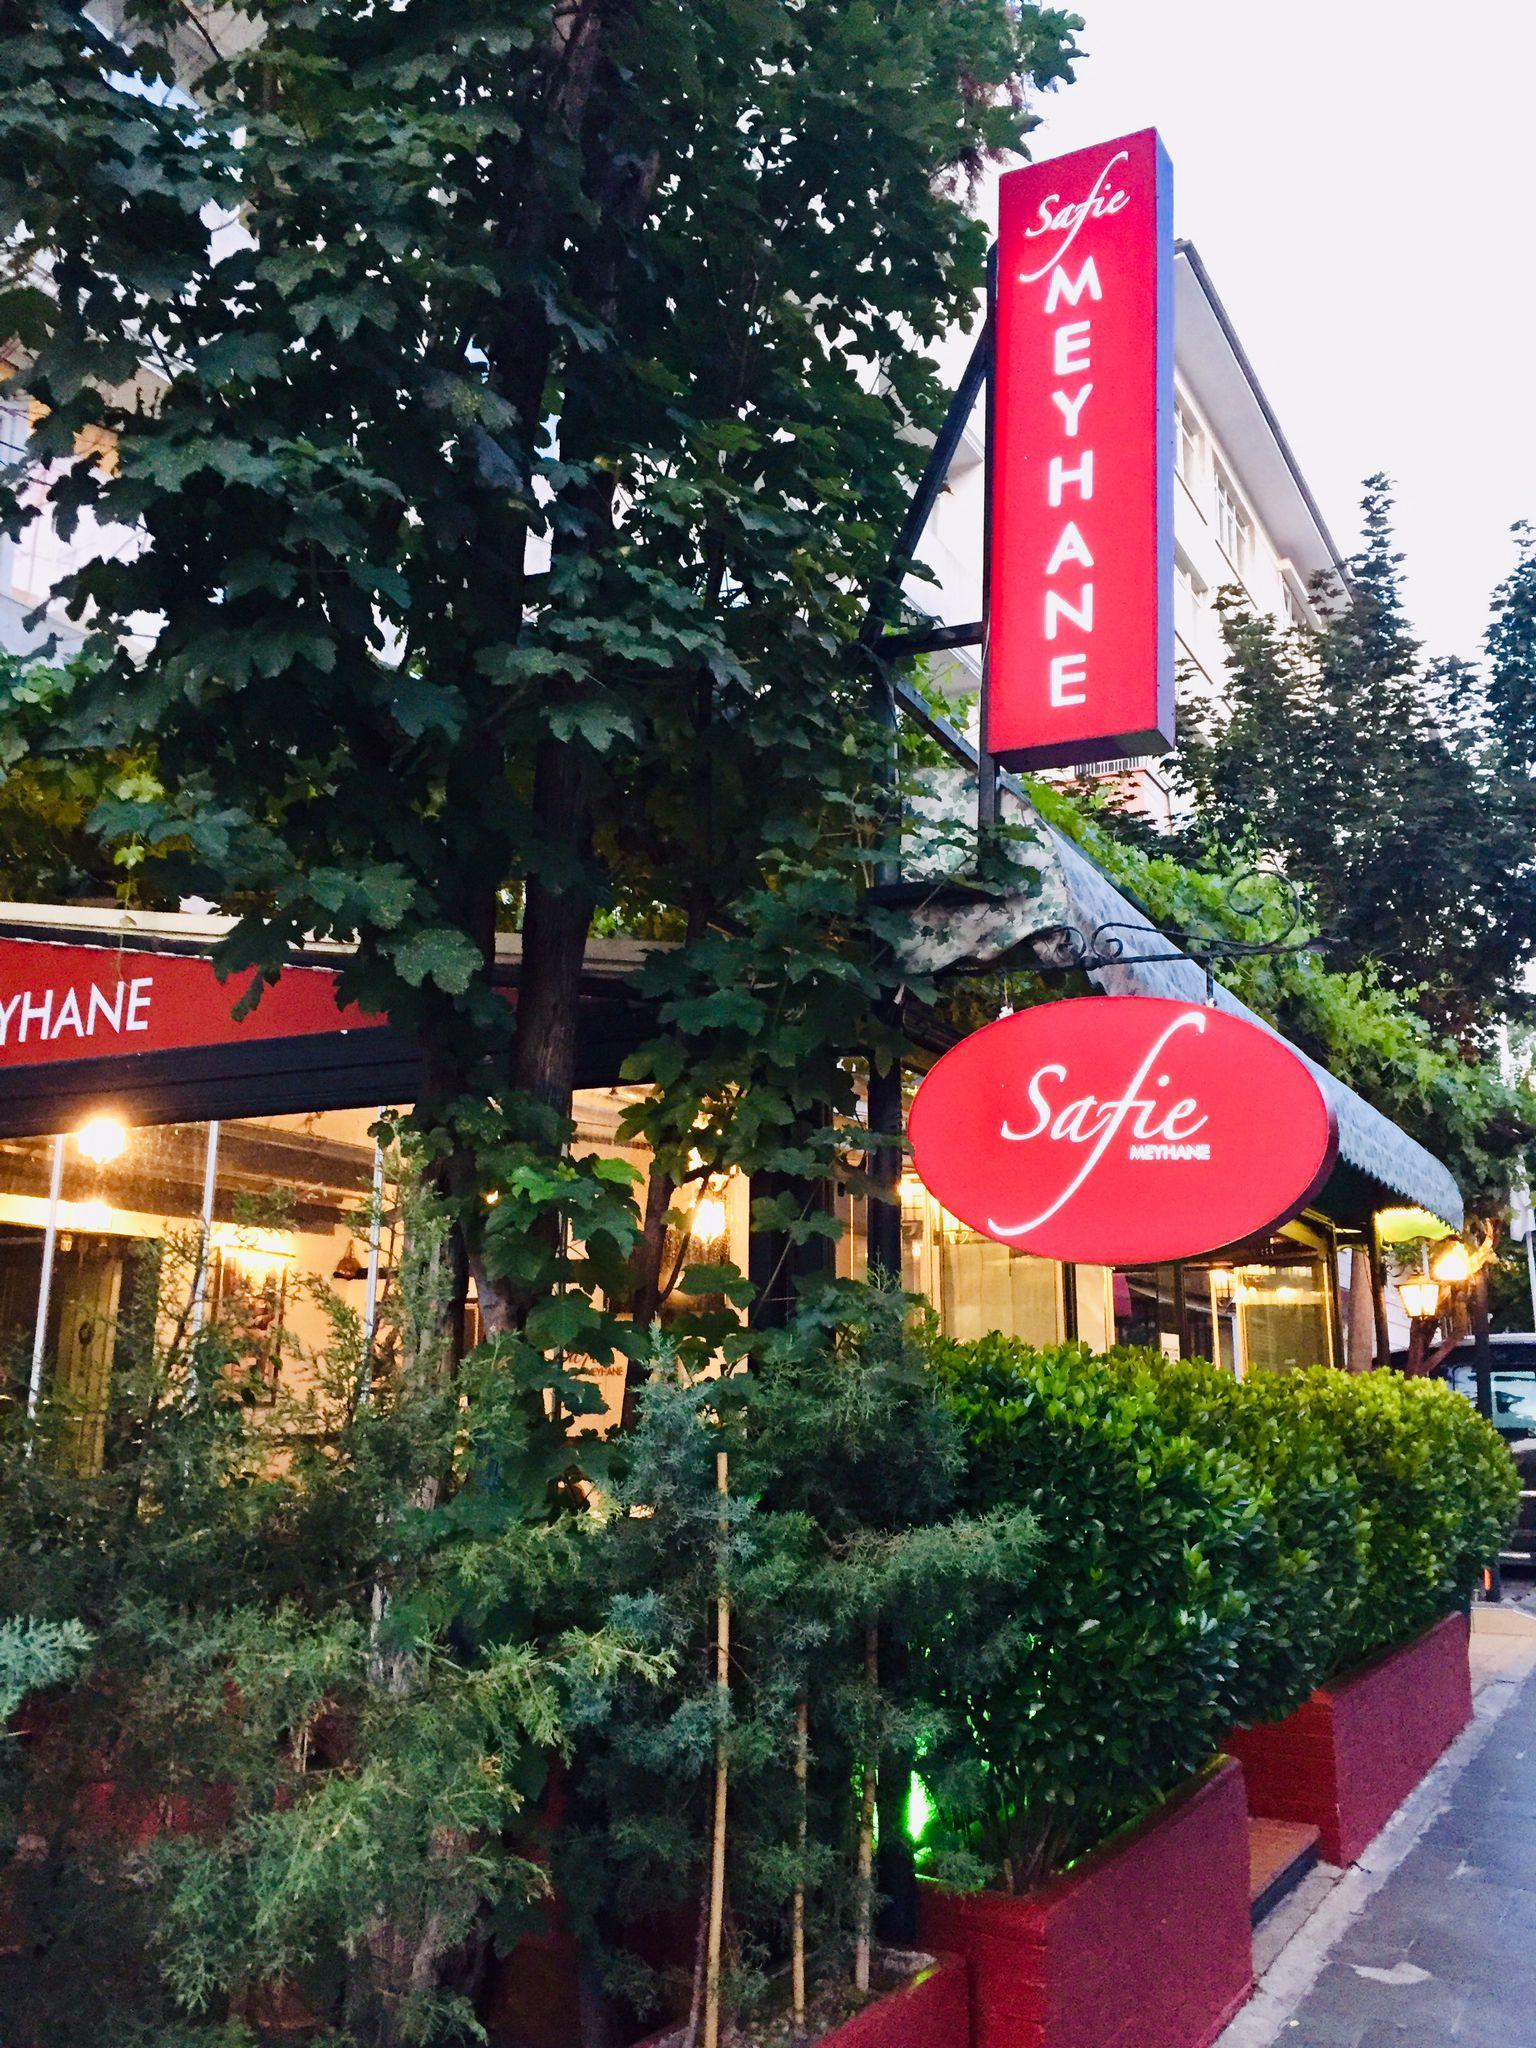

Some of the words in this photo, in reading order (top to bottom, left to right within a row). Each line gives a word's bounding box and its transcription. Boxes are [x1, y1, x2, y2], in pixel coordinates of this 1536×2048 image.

[1019, 150, 1131, 282] Safie
[1044, 255, 1102, 708] MEYHANE
[0, 976, 153, 1046] YHANE
[988, 1011, 1209, 1237] Safie
[587, 1366, 624, 1376] EYHANE
